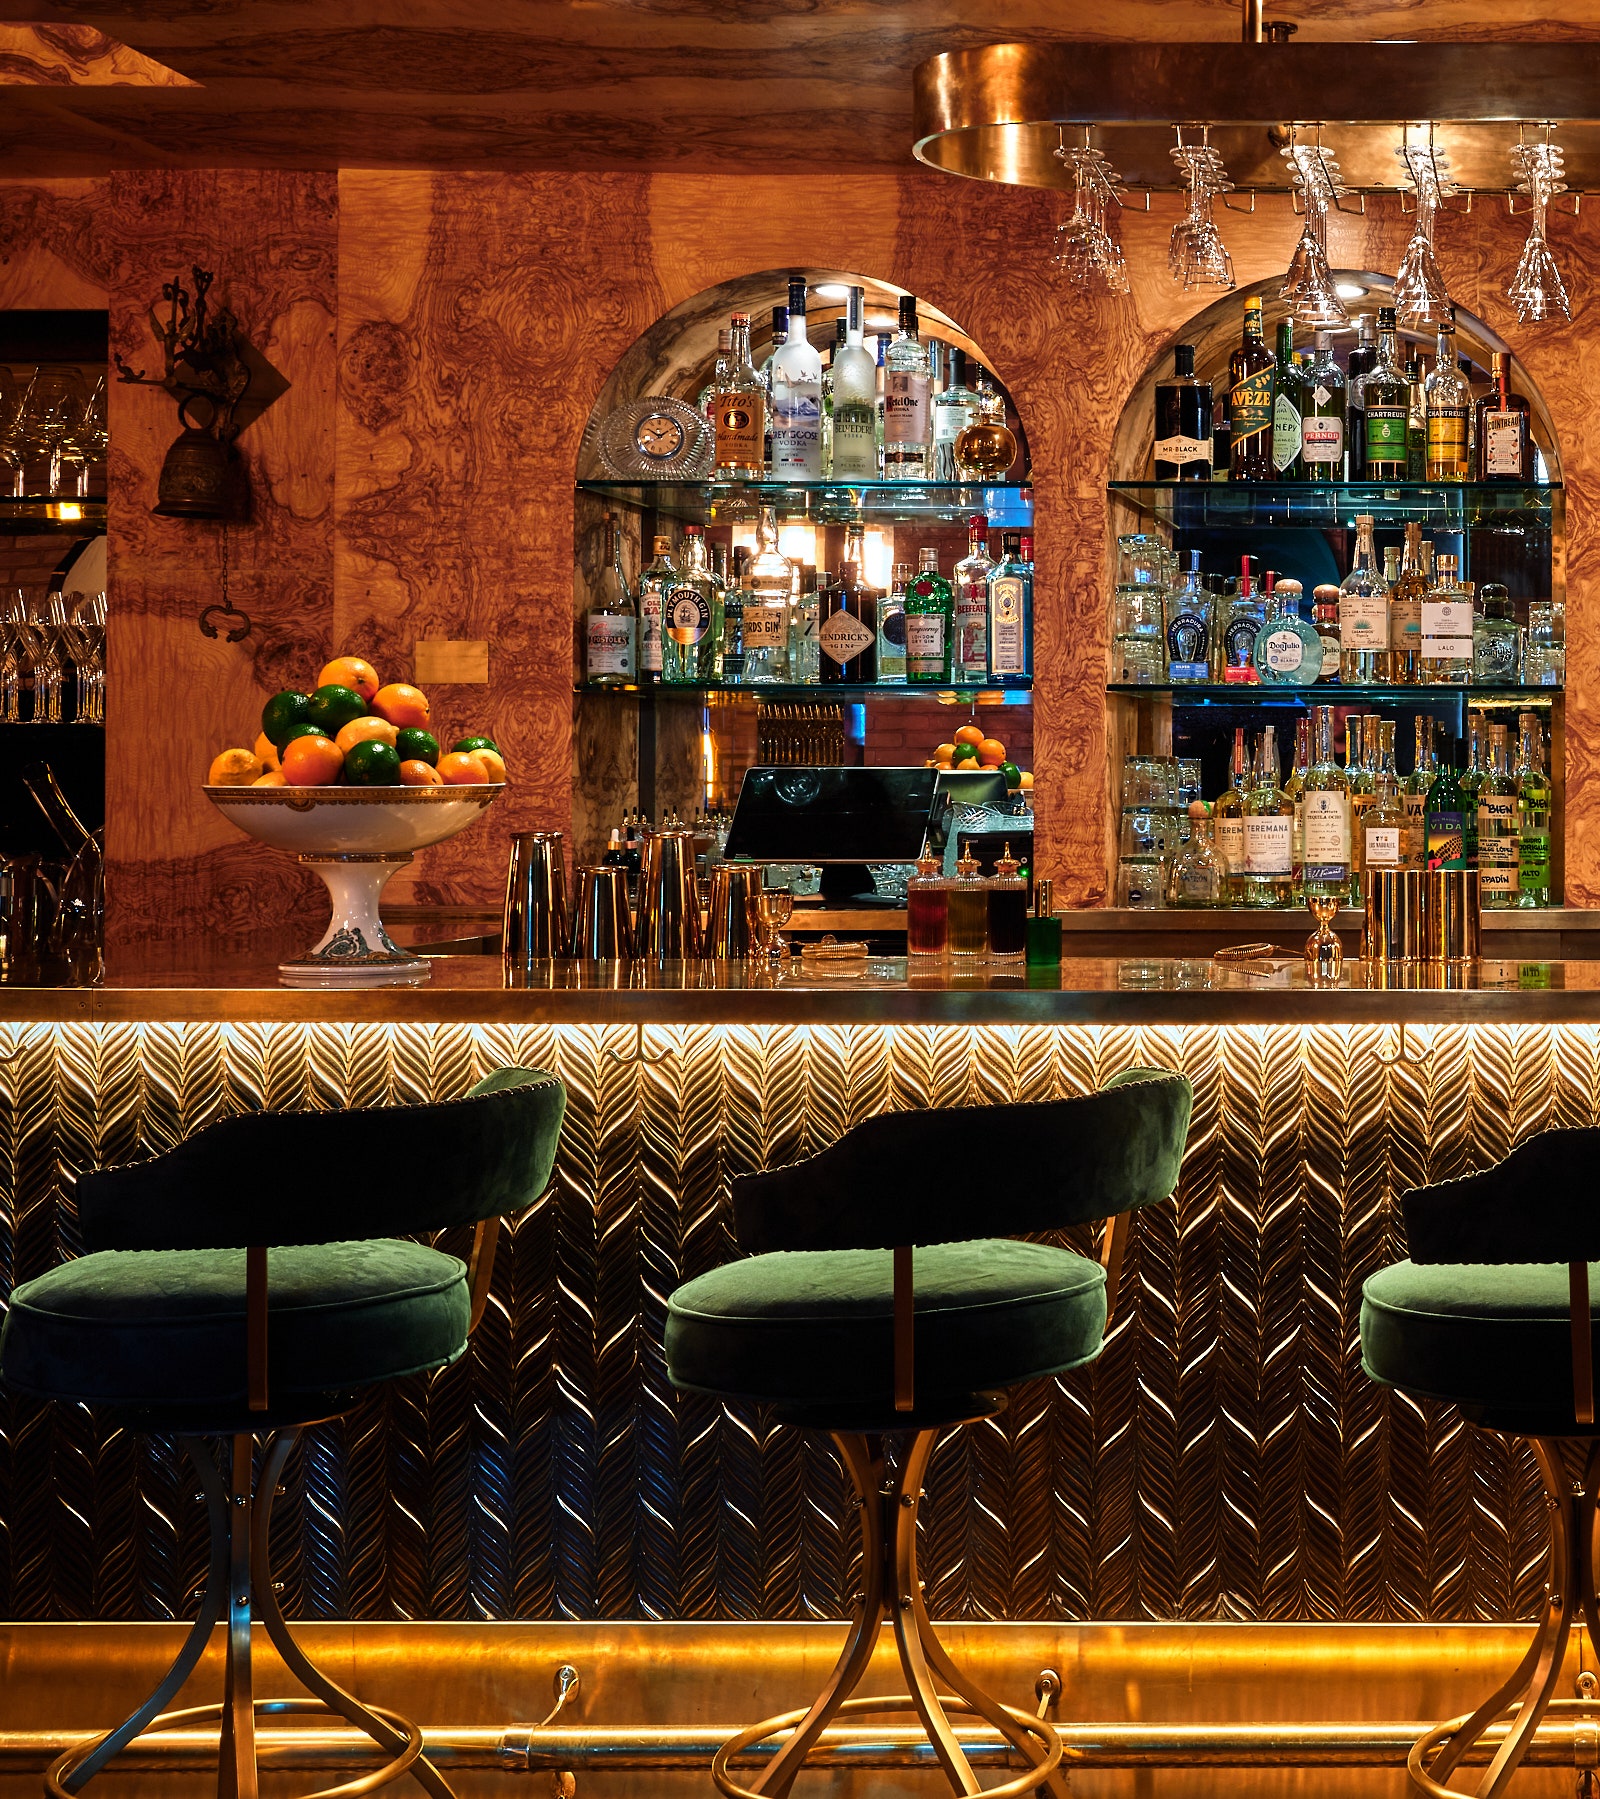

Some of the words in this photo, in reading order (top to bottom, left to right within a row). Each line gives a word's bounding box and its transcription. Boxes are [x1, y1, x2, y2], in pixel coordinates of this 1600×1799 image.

[720, 395, 755, 408] Tito's
[904, 397, 919, 407] One
[1231, 388, 1272, 406] AVÈZE
[1368, 410, 1407, 419] CHARTREUSE
[1428, 410, 1467, 419] CHARTREUSE
[835, 423, 873, 434] BELVEDERE
[1487, 415, 1519, 431] COINTREAU
[789, 430, 819, 441] GOOSE
[666, 590, 701, 619] PLYMOUTH
[699, 603, 709, 619] GIN
[958, 605, 987, 614] BEEFEATE
[764, 622, 778, 633] GIN
[1171, 618, 1204, 634] HERRADURA
[1228, 622, 1257, 637] HERRADUR
[1488, 803, 1514, 815] BIEN
[1218, 826, 1243, 835] TEREM
[1246, 824, 1289, 834] TEREMANA
[1431, 823, 1463, 831] VIDA
[1481, 872, 1510, 884] SPADÍN
